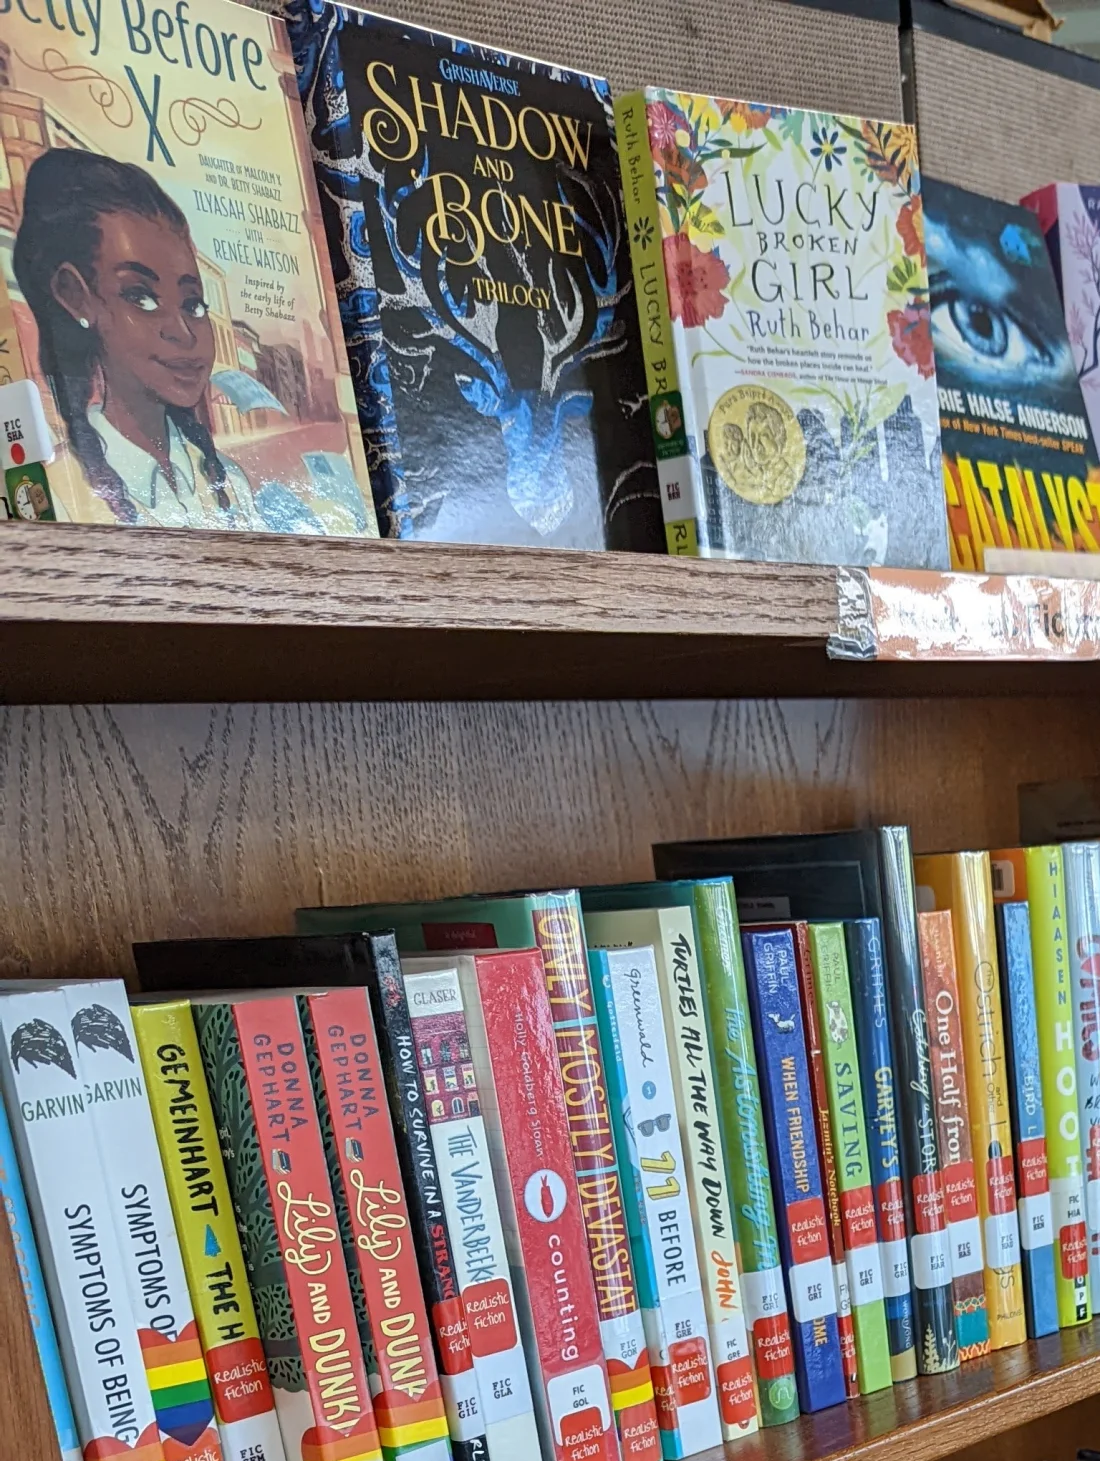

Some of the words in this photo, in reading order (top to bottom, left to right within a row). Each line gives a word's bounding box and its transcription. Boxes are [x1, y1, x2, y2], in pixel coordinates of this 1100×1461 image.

[121, 0, 267, 91] Before
[124, 65, 176, 167] X
[363, 61, 592, 171] SHADOW
[199, 153, 236, 173] DAUGHTER
[244, 164, 275, 185] MALCOLM
[231, 178, 251, 194] BETTY
[252, 183, 281, 201] SHABAZZ
[473, 155, 514, 183] AND
[193, 190, 245, 221] ILYASAH
[248, 203, 301, 234] SHABAZZ
[411, 168, 583, 266] BONE
[721, 170, 880, 232] LUCKY
[213, 238, 252, 266] RENÉE
[254, 250, 300, 275] WATSON
[245, 228, 264, 244] WITH
[756, 231, 858, 256] BROKEN
[245, 275, 274, 292] Inspired
[254, 290, 272, 306] early
[472, 277, 552, 309] TRILOGY
[639, 261, 664, 347] LUCKY
[752, 259, 869, 303] GIRL
[245, 303, 263, 317] Betty
[265, 307, 296, 322] Shabazz
[746, 308, 800, 341] Ruth
[807, 308, 870, 342] Behar
[4, 418, 22, 432] FIC
[7, 430, 24, 443] SHA
[967, 394, 1015, 423] HALSE
[1017, 404, 1089, 440] ANDERSON
[1049, 862, 1067, 1005] HIAASEN
[538, 914, 592, 1018] ONLY
[671, 932, 699, 1018] TURTLES
[763, 942, 778, 995] GRIFFIN
[774, 949, 792, 986] PAUL
[413, 989, 458, 1006] GLASER
[623, 967, 648, 1069] Greenwald
[935, 989, 954, 1046] One
[253, 1033, 291, 1143] GEPHART
[276, 1042, 308, 1129] DONNA
[328, 1024, 363, 1131] GEPHART
[350, 1033, 379, 1118] DONNA
[556, 1029, 617, 1167] MOSTLY
[688, 1071, 709, 1117] THE
[781, 1056, 797, 1102] WHEN
[21, 1093, 85, 1123] GARVIN
[397, 1034, 414, 1076] HOW
[408, 1107, 435, 1181] SURVIVE
[835, 1062, 863, 1177] SAVING
[448, 1125, 477, 1158] THE
[692, 1120, 717, 1171] WAY
[787, 1106, 811, 1194] FRIENDSHIP
[157, 1043, 219, 1217] GEMEINHART
[206, 1261, 236, 1316] THE
[701, 1178, 727, 1239] DOWN
[121, 1183, 171, 1309] SYMPTOMS
[277, 1181, 336, 1275] Lily
[308, 1281, 331, 1324] AND
[350, 1168, 406, 1261] Lily
[379, 1267, 401, 1309] AND
[658, 1209, 687, 1287] BEFORE
[64, 1203, 117, 1333] SYMPTOMS
[466, 1291, 510, 1314] Realistic
[548, 1234, 580, 1361] counting
[95, 1337, 122, 1368] OF
[214, 1359, 266, 1385] Realistic
[102, 1371, 140, 1444] BEING
[457, 1397, 477, 1411] FIC
[492, 1378, 511, 1391] FIC
[494, 1388, 513, 1400] GLA
[458, 1407, 478, 1419] GIL
[240, 1444, 263, 1459] FIC
